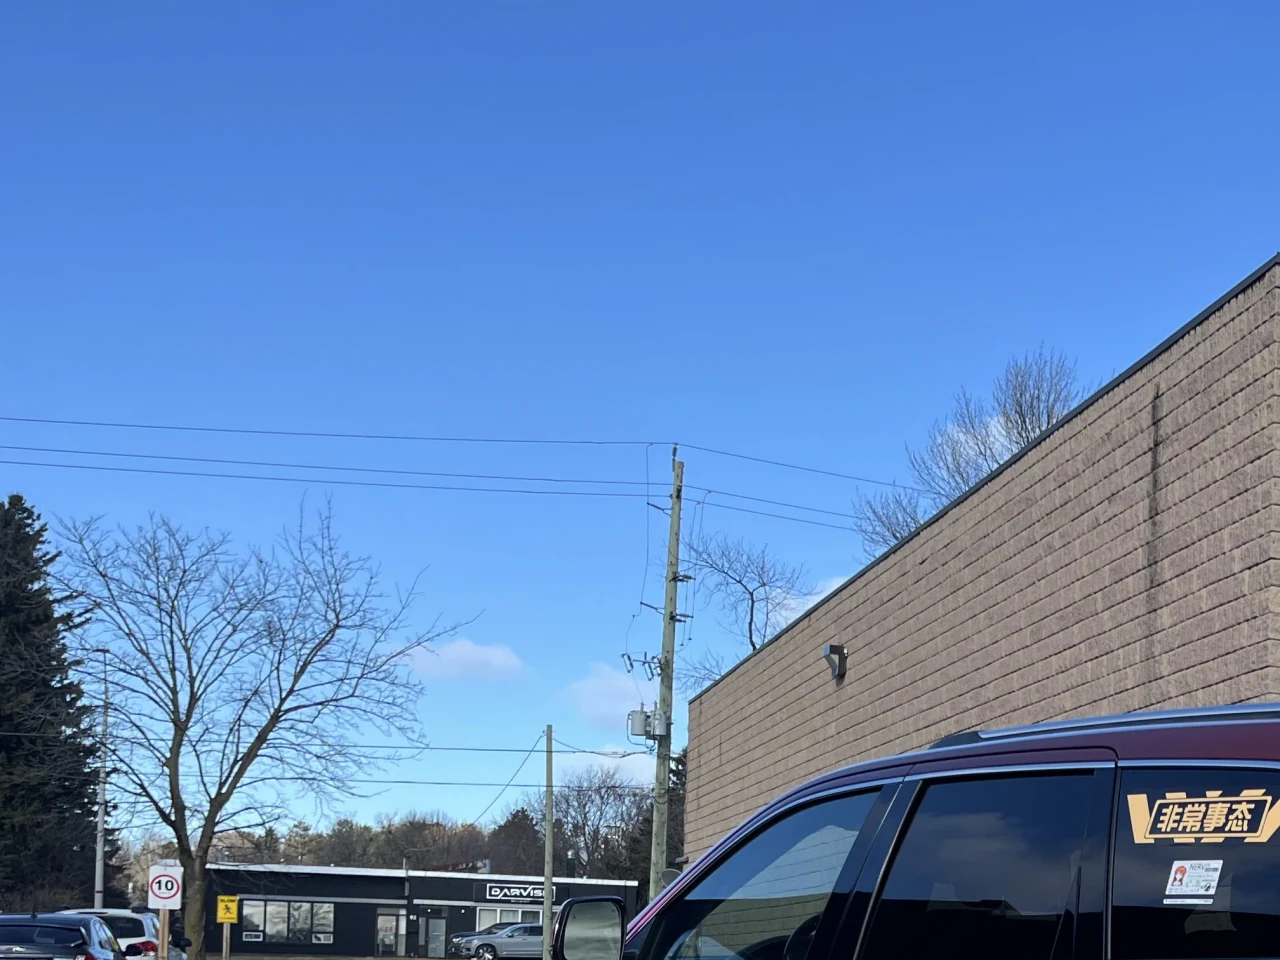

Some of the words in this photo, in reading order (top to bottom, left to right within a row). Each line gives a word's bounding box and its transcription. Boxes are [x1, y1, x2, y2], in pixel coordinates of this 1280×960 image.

[1157, 801, 1256, 832] 非常事态
[155, 880, 174, 891] 10
[491, 885, 545, 897] DARVIS
